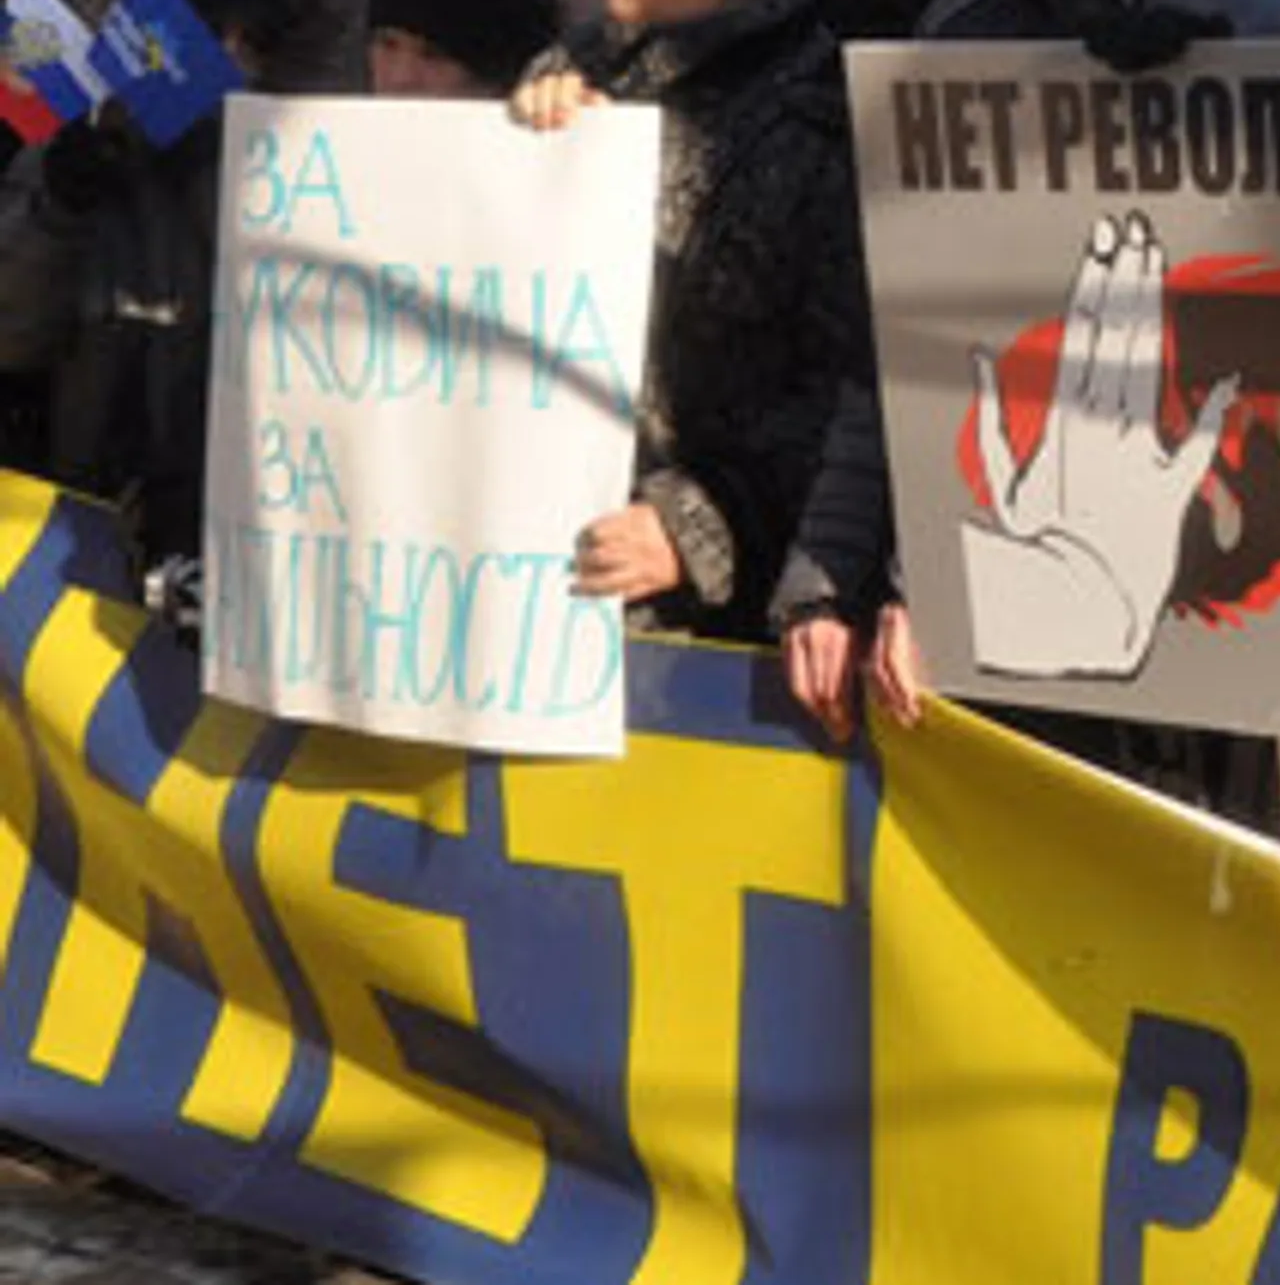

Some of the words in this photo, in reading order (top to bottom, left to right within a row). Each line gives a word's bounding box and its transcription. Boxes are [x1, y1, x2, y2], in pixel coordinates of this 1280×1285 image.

[242, 128, 353, 238] ЗА
[893, 78, 1021, 193] НЕТ
[256, 420, 346, 523] ЗА
[28, 583, 846, 1284] НЕТ
